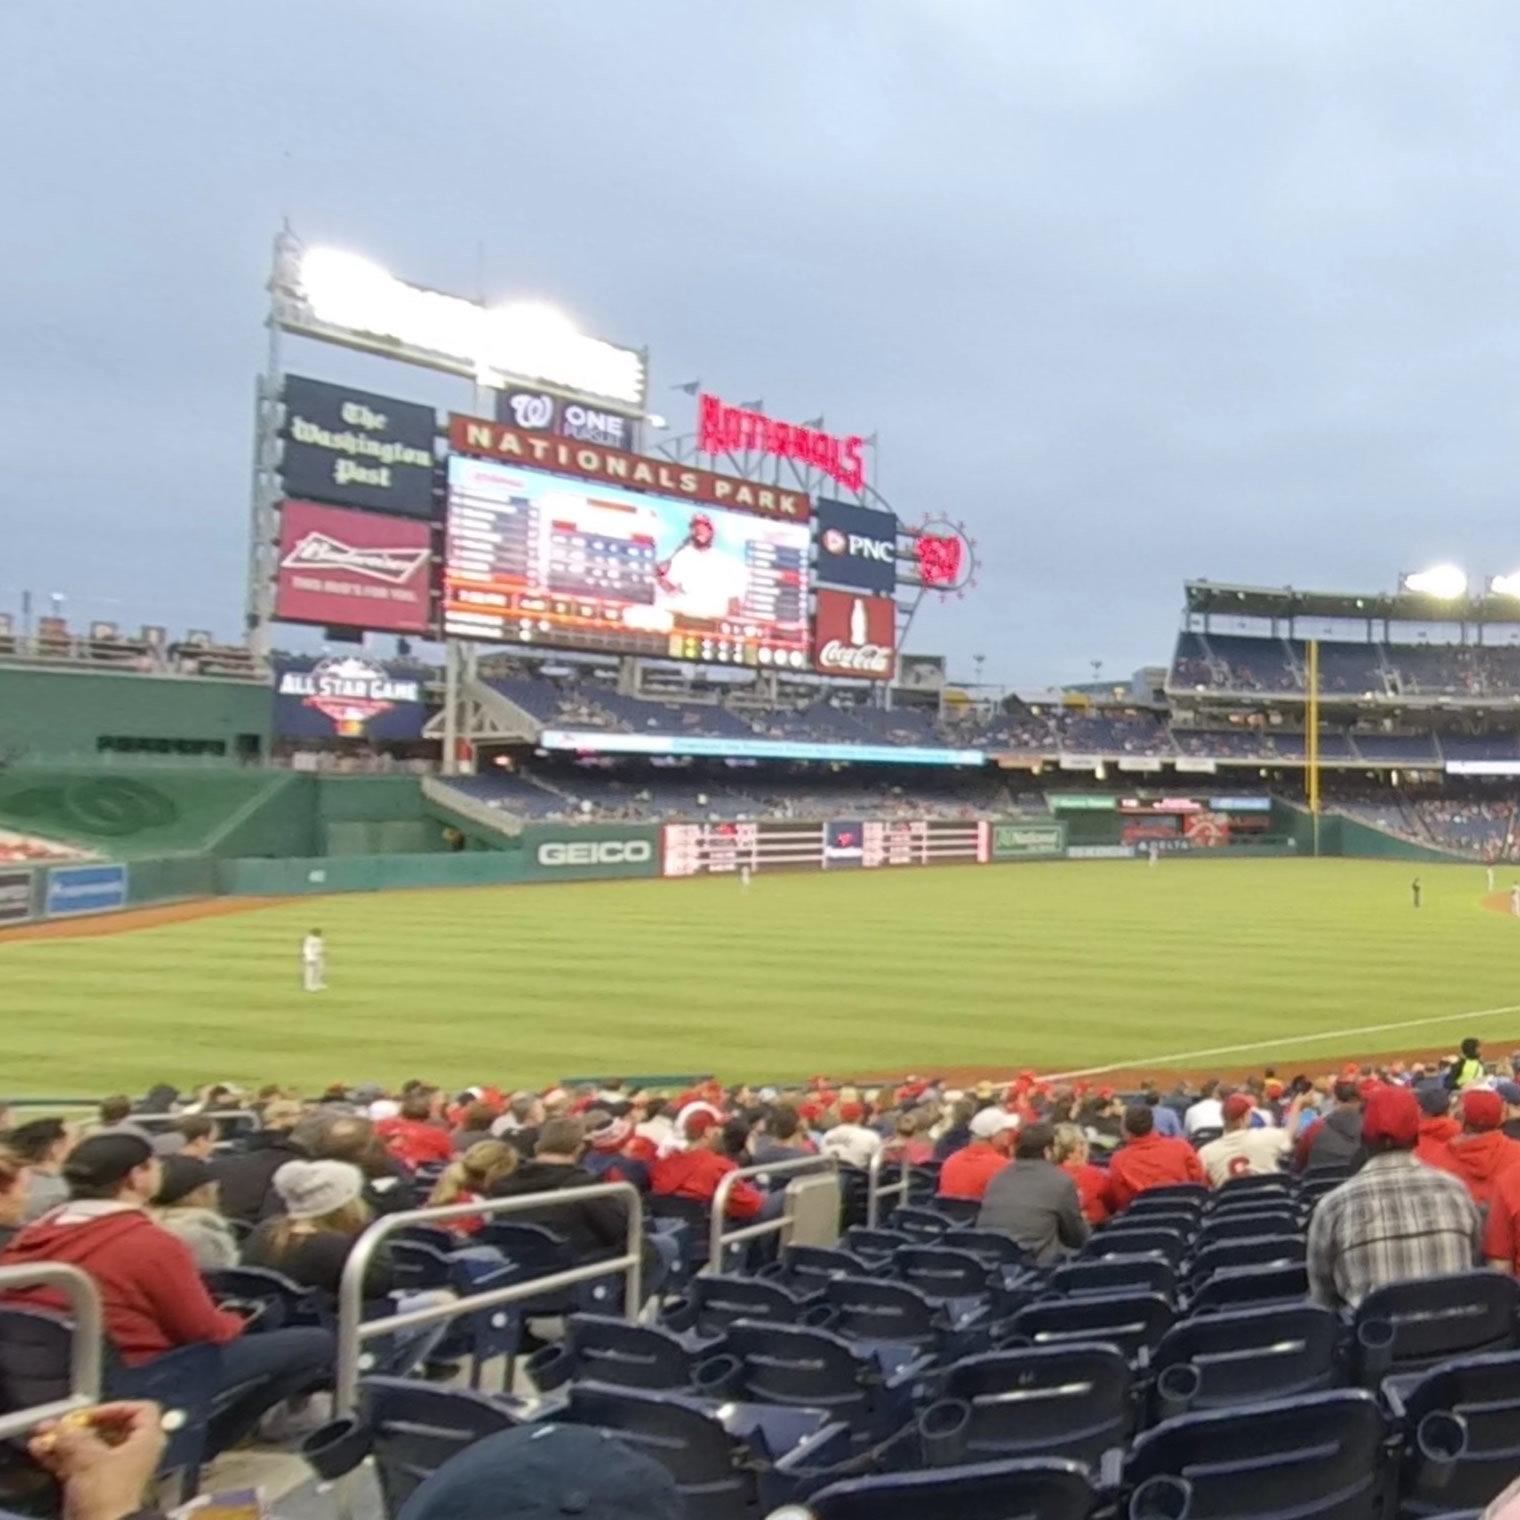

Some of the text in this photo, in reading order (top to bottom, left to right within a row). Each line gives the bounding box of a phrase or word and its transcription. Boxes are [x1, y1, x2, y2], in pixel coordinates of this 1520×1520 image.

[341, 401, 388, 430] The
[564, 404, 625, 436] ONE
[290, 415, 433, 467] Washington
[563, 423, 624, 447] PURSUIT
[332, 457, 391, 488] Post
[466, 423, 699, 493] NATIONALS
[714, 480, 798, 514] PARK
[848, 535, 896, 563] PNC
[278, 672, 420, 702] ALL STAR GAME
[537, 839, 651, 867] GEICO
